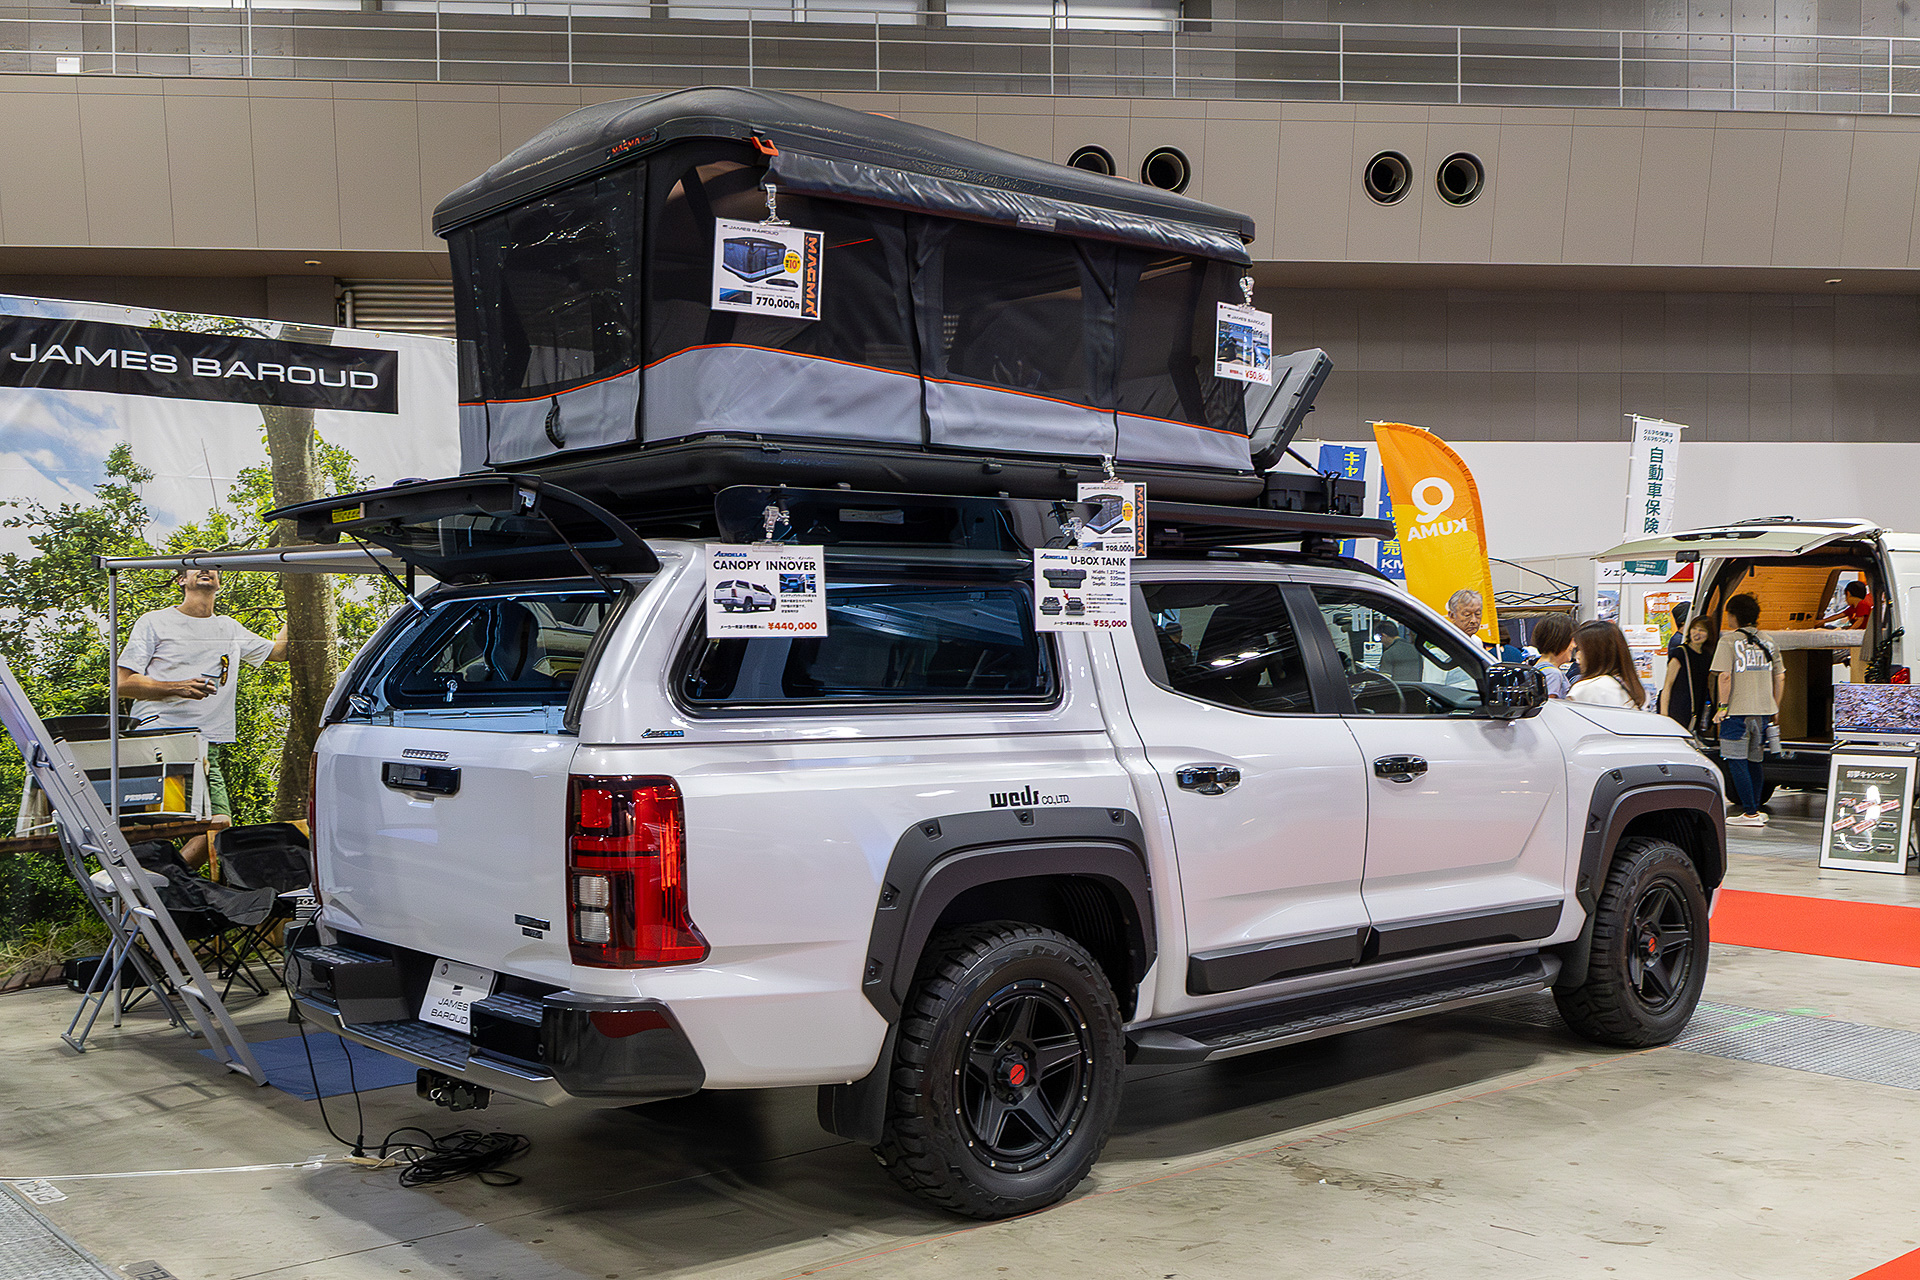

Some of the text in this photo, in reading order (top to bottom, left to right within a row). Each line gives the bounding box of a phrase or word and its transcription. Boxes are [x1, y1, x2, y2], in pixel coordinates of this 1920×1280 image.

[10, 343, 379, 390] JAMES BAROUD
[1643, 446, 1664, 534] 自動車保険
[713, 560, 817, 571] CANOPY INNOVER
[1070, 556, 1126, 567] U-BOX TANK
[768, 622, 818, 632] ¥440,000
[1093, 619, 1127, 629] ¥55,000
[989, 784, 1039, 808] weds
[438, 997, 469, 1012] JAMES
[431, 1008, 469, 1025] BAROUD
